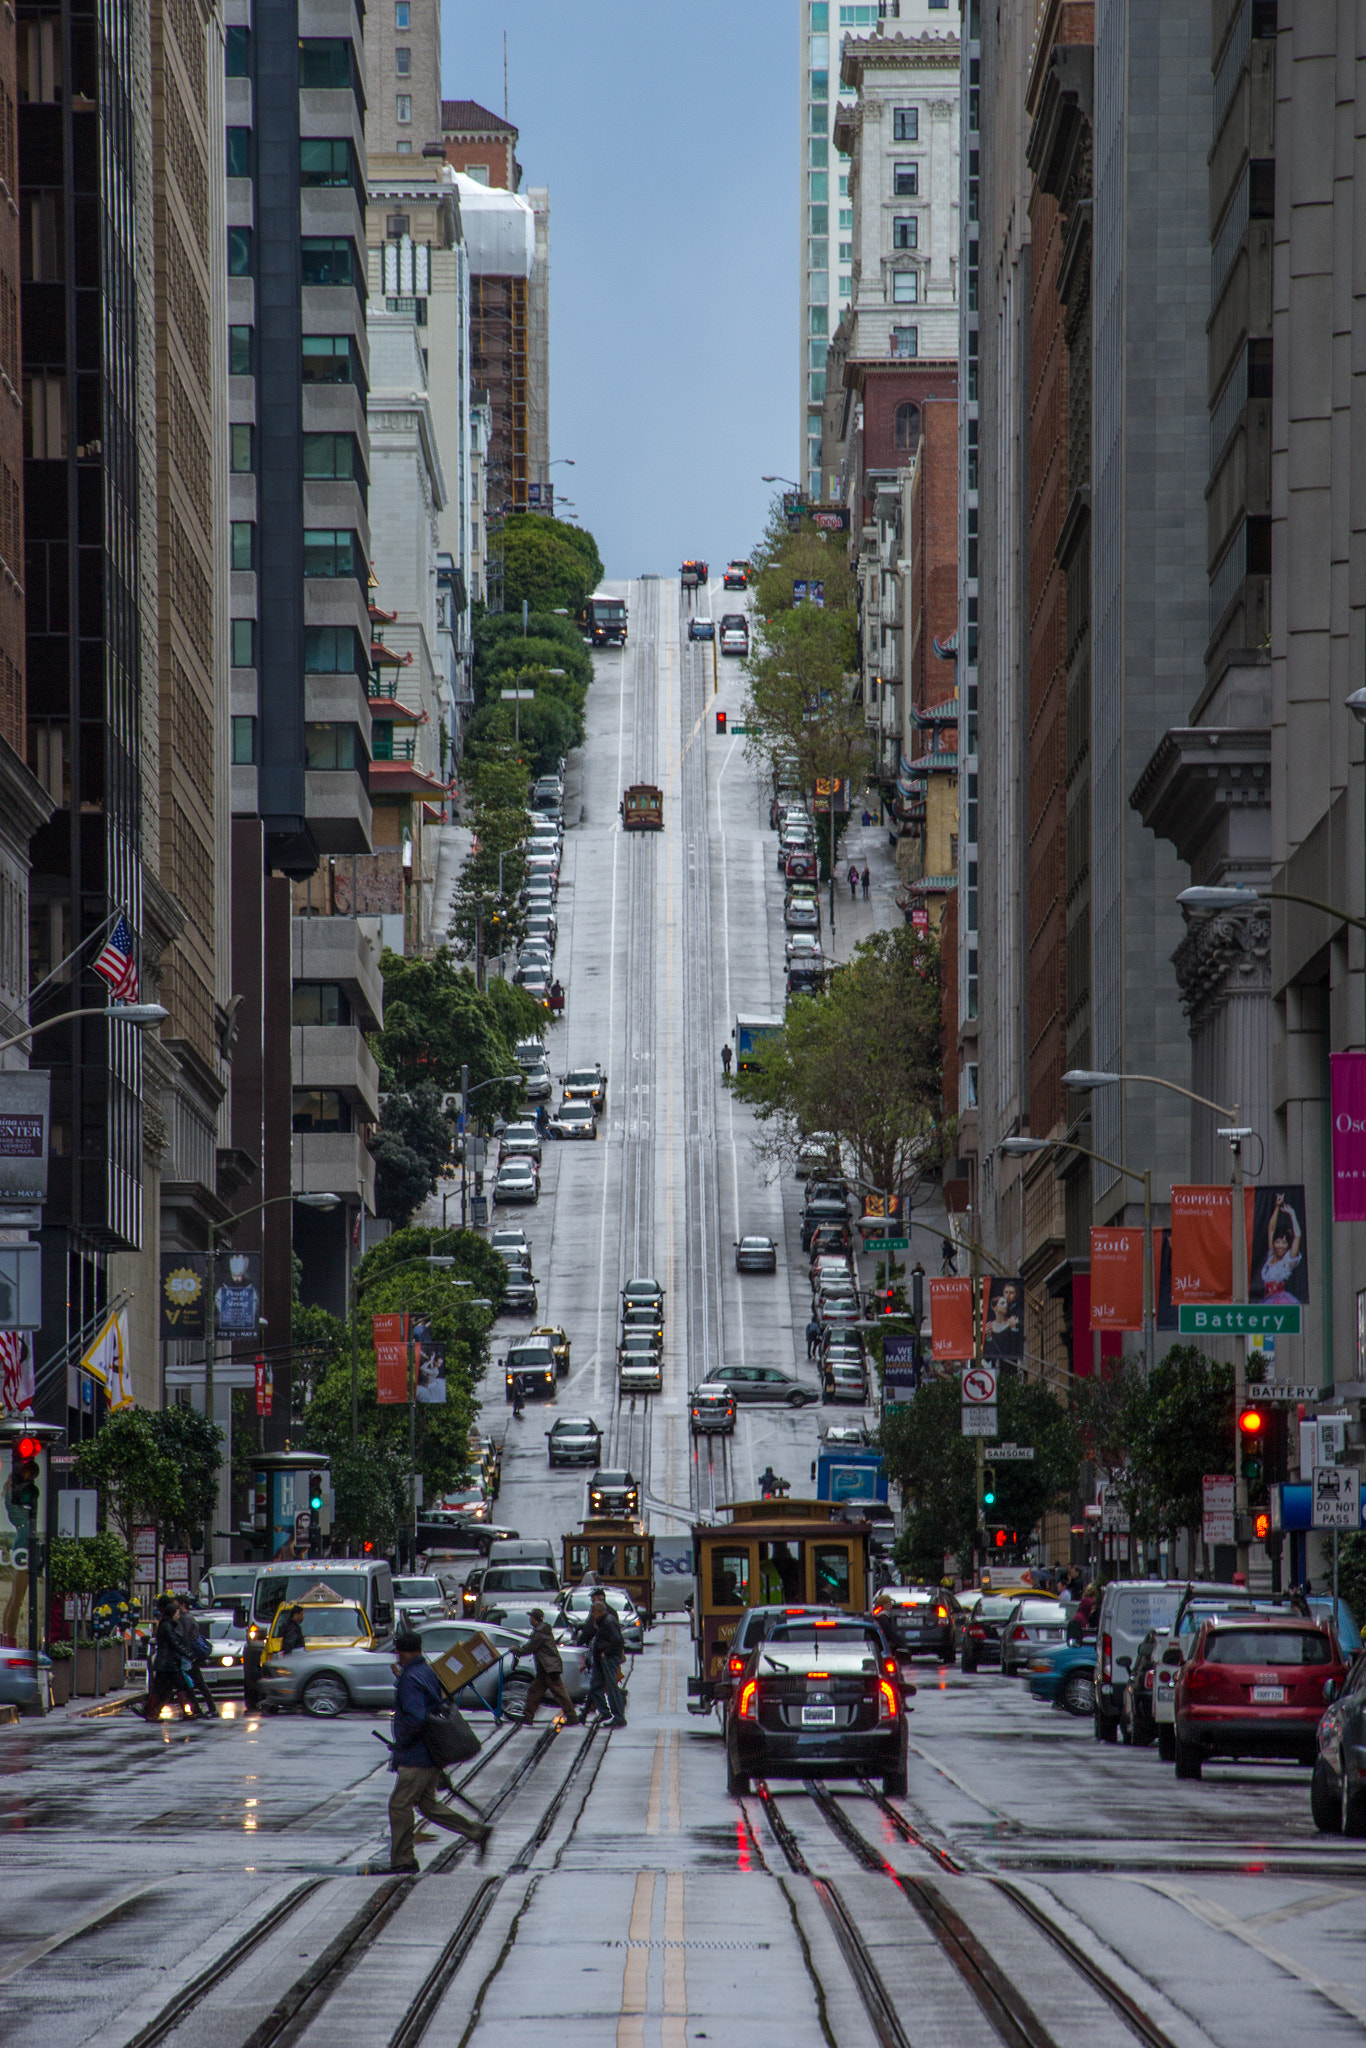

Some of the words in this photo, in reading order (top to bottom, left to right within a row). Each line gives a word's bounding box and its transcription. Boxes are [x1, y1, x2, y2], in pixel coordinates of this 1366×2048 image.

[1094, 1238, 1129, 1252] 2016
[171, 1279, 196, 1291] 50
[1195, 1312, 1284, 1331] Battery
[897, 1346, 912, 1355] WE
[885, 1354, 912, 1363] MAKE
[1252, 1387, 1314, 1397] BATTERY
[1316, 1503, 1330, 1511] DO
[1336, 1502, 1355, 1511] NOT
[1323, 1514, 1349, 1523] PASS
